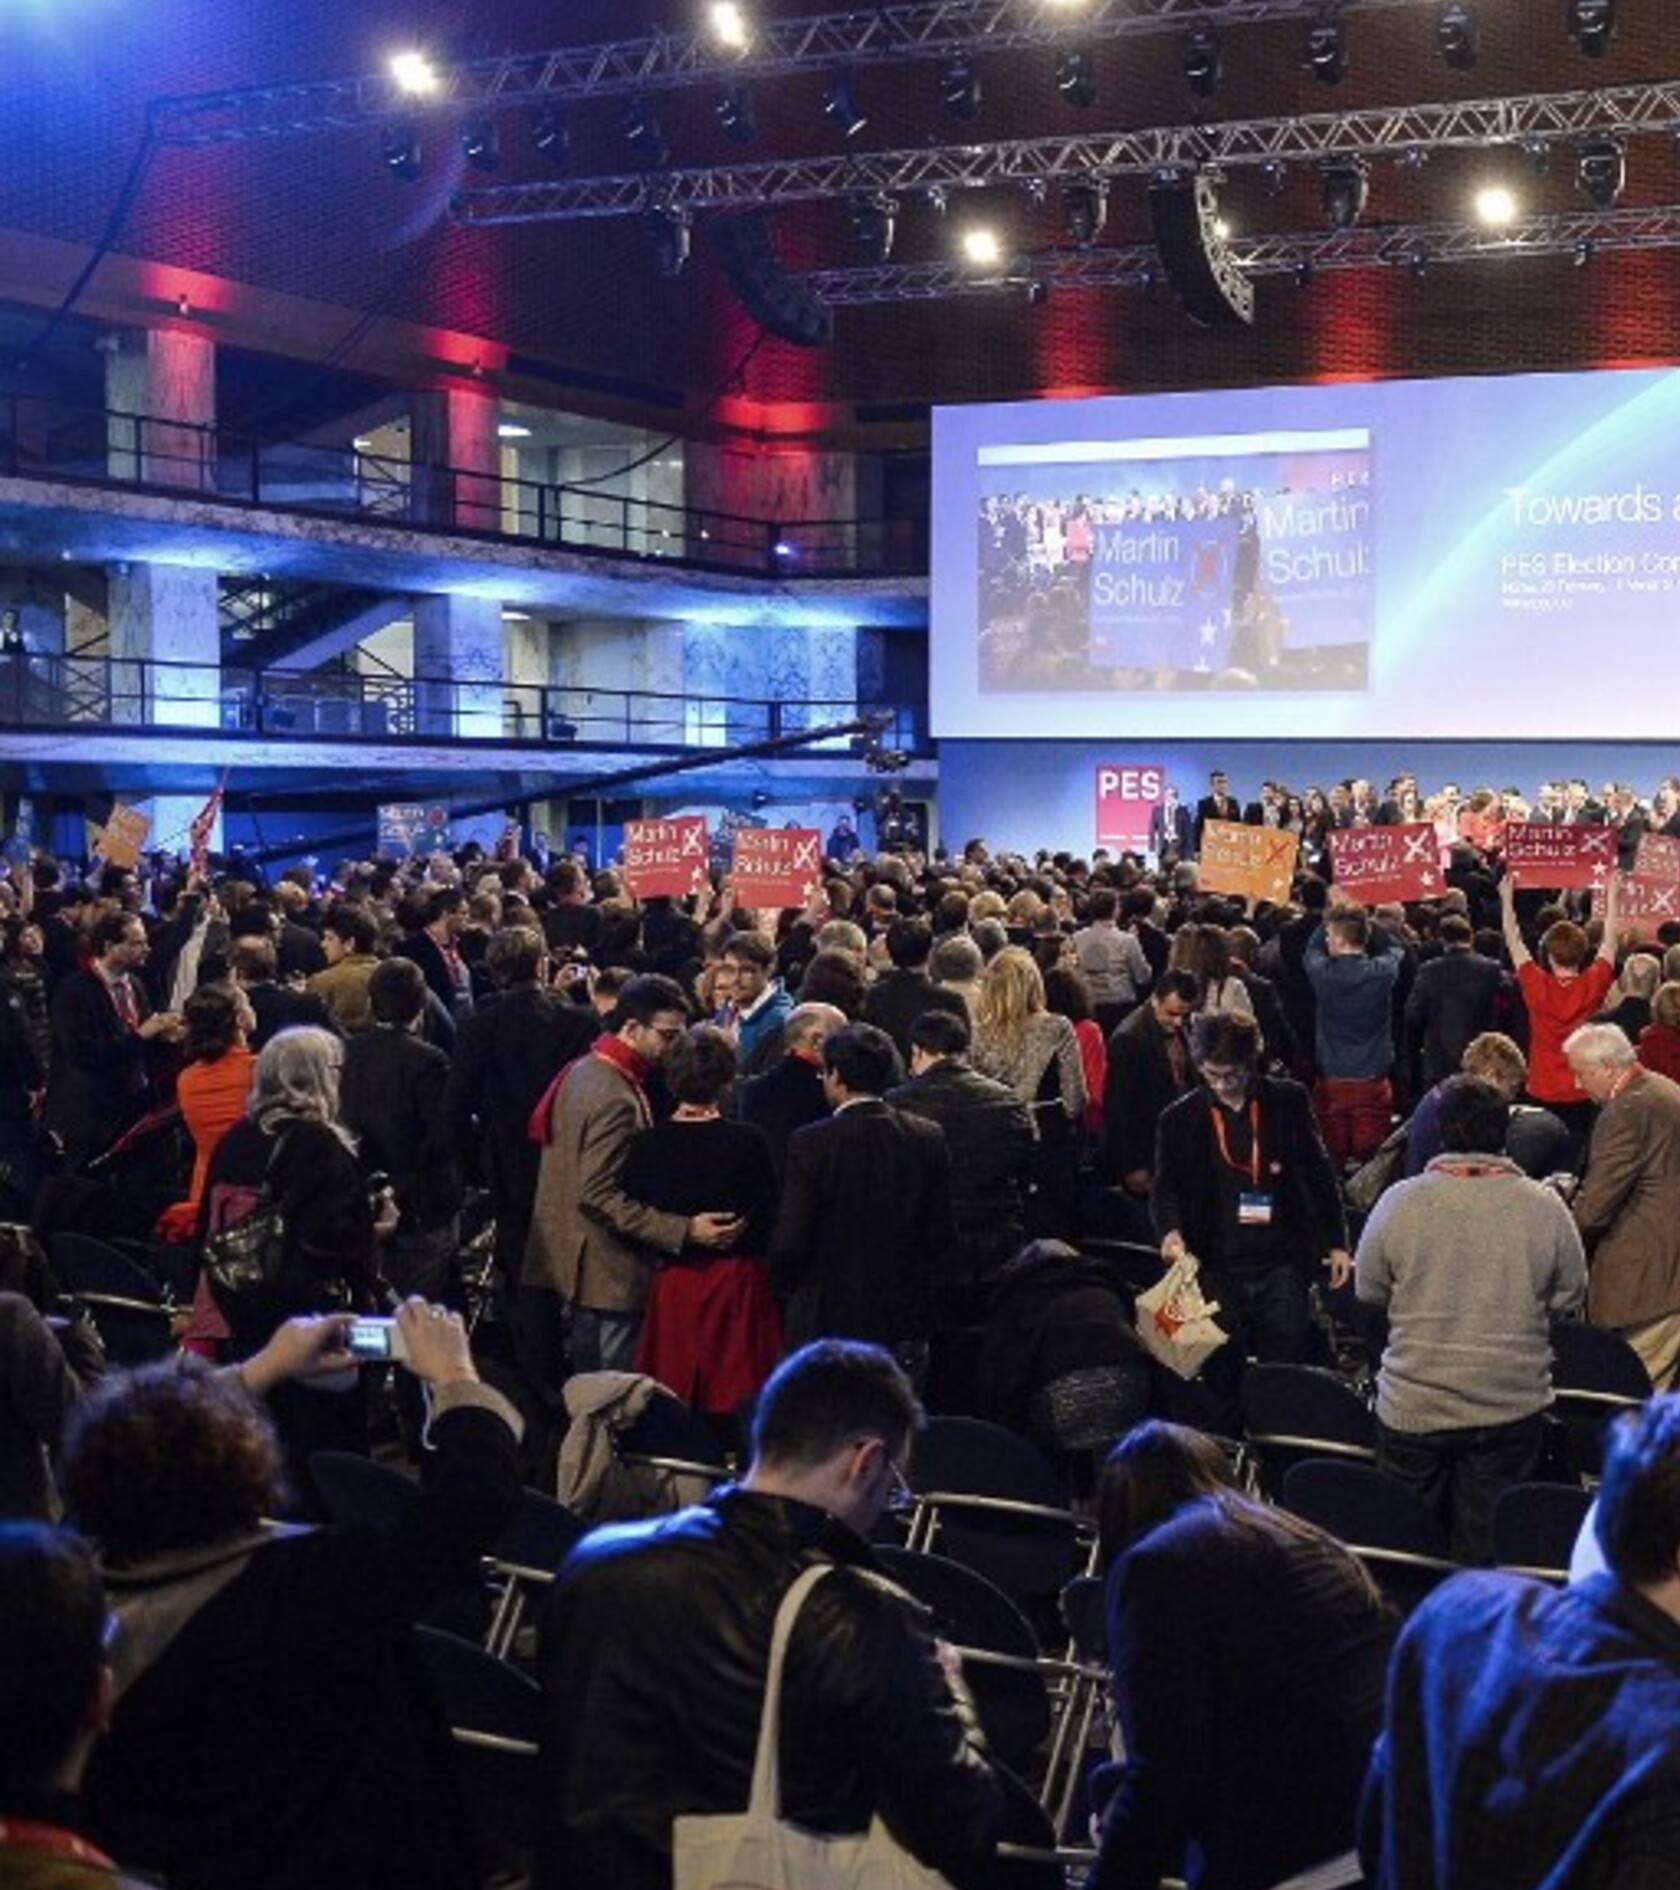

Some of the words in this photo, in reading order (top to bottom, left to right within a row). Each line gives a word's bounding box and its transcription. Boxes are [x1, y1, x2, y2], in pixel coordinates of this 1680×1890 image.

[1505, 484, 1662, 527] Towards
[1100, 531, 1179, 564] Martin
[1268, 538, 1368, 584] Schul
[1502, 554, 1546, 576] PES
[1553, 552, 1635, 575] Election
[1095, 573, 1185, 608] Schulz
[1100, 770, 1160, 800] PES
[1508, 825, 1573, 840] Martin
